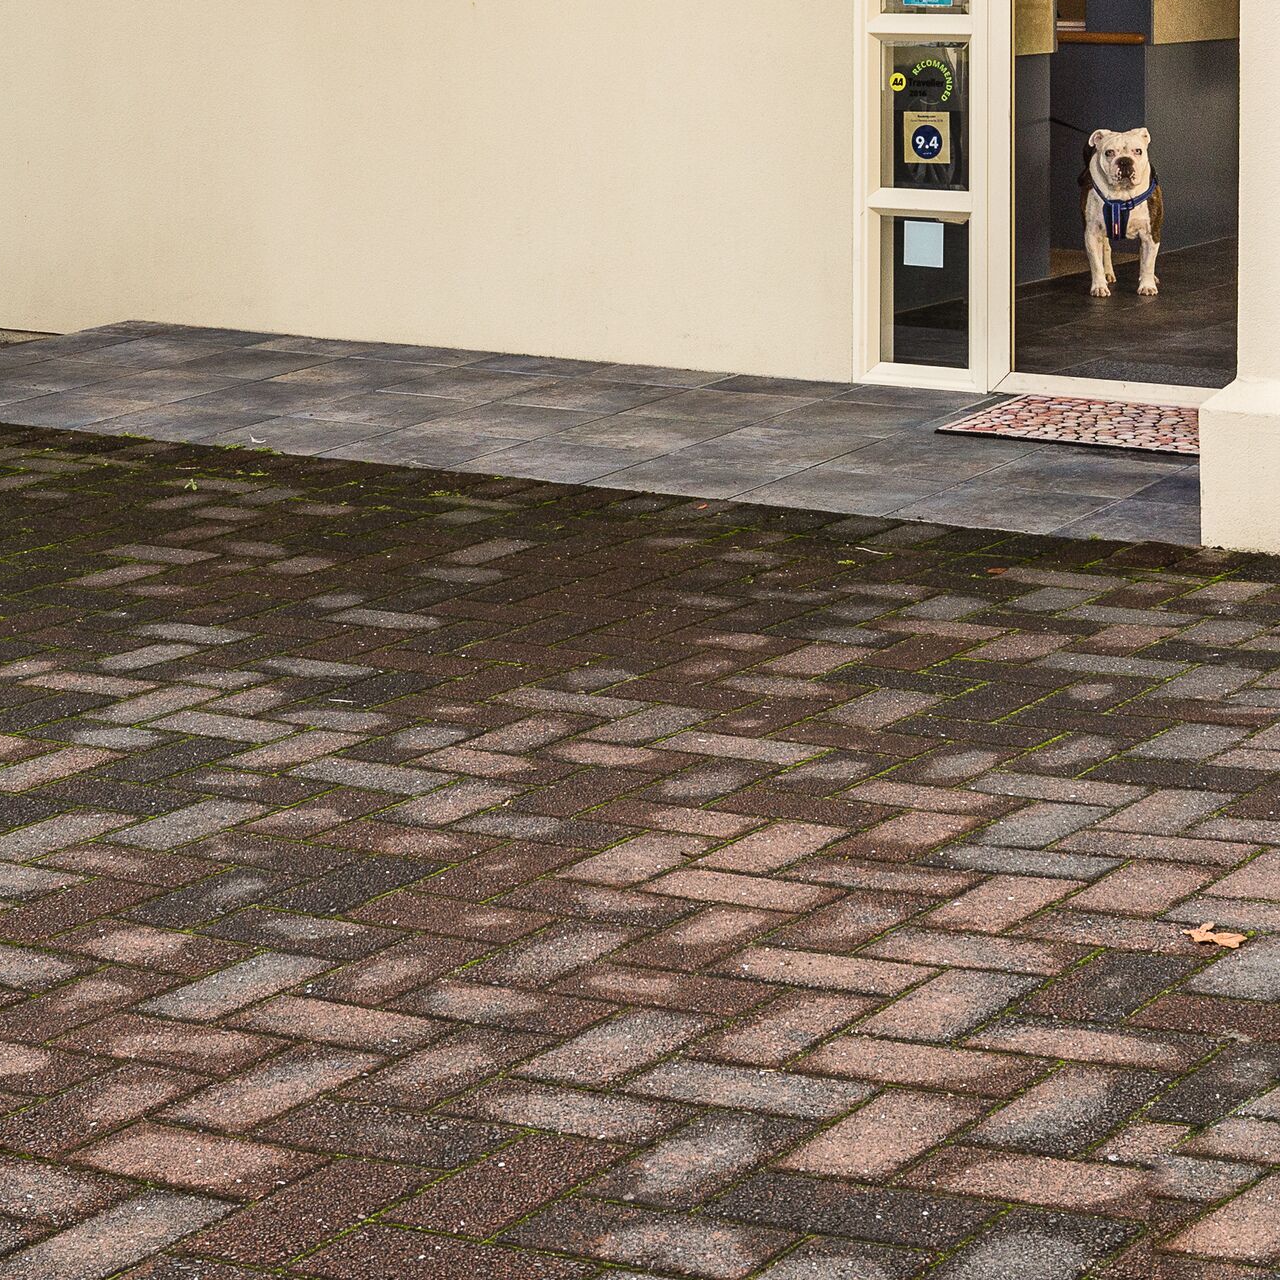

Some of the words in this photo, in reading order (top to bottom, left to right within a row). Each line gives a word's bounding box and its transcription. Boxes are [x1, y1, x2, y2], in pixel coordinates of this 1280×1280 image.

[893, 78, 903, 86] AA
[908, 78, 944, 87] Traveller
[912, 59, 953, 102] RECOMMENDED
[915, 135, 939, 149] 9.4
